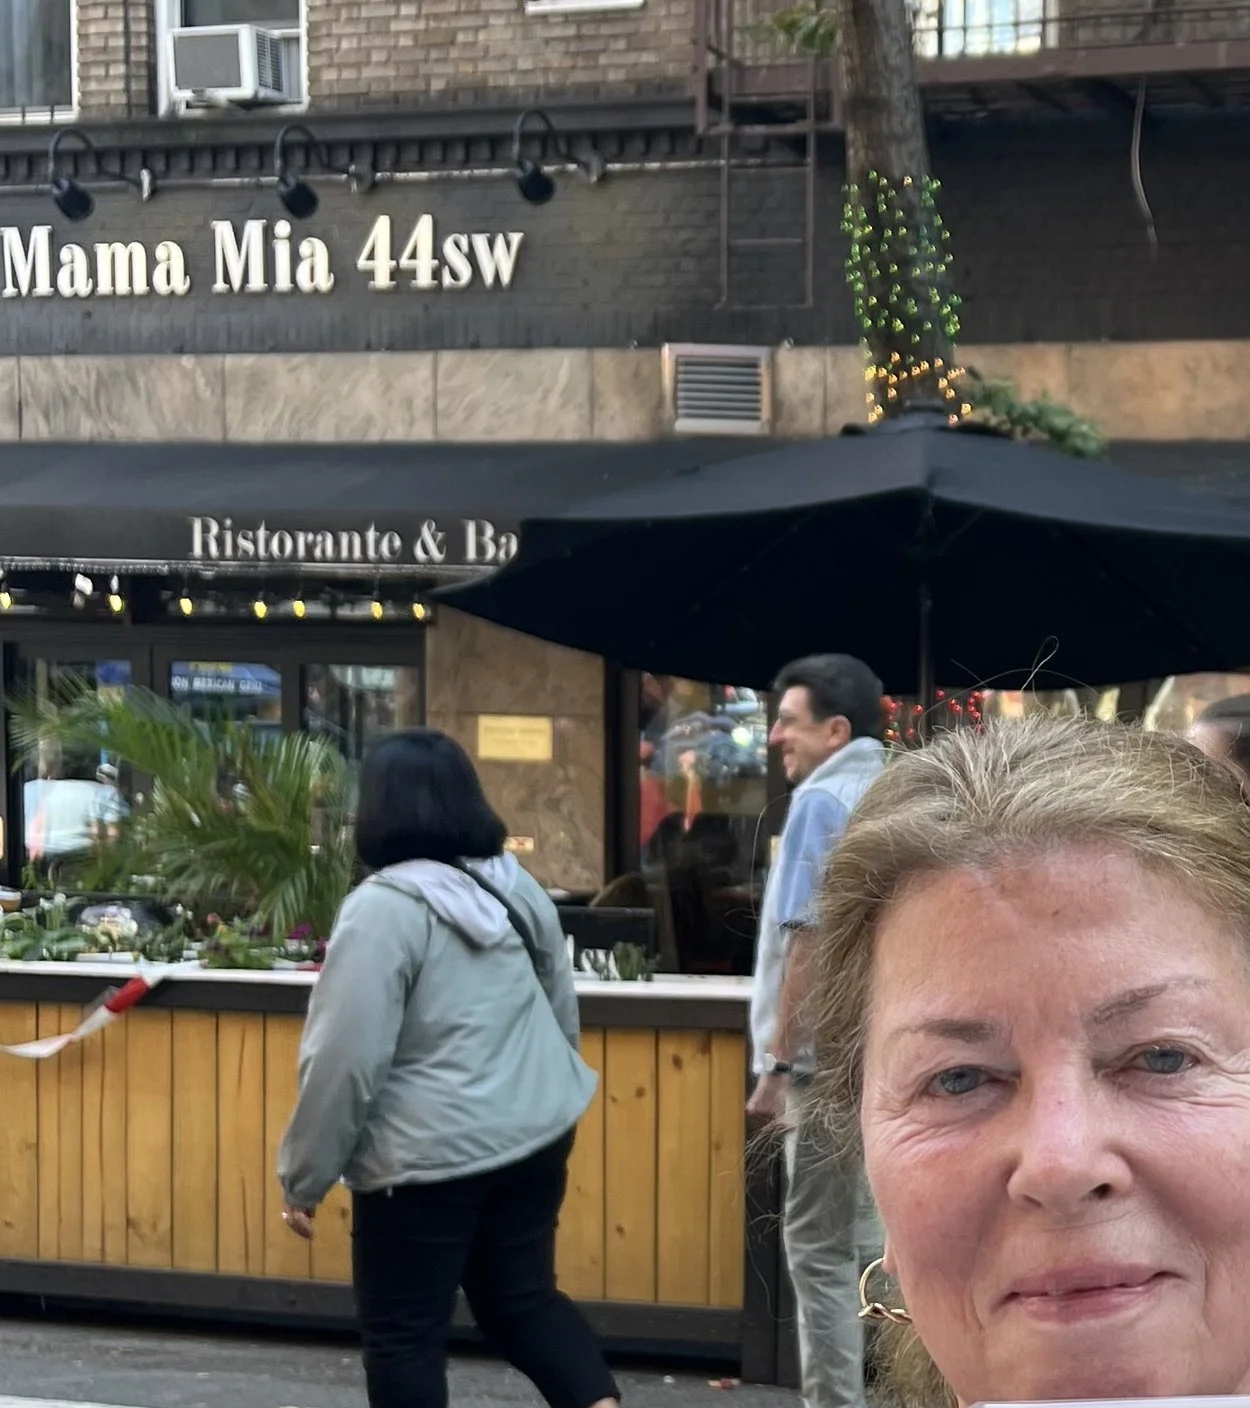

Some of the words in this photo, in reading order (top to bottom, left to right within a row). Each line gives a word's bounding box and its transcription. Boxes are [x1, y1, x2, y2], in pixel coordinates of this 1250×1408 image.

[1, 225, 190, 297] Mama
[211, 219, 335, 294] Mia
[357, 213, 523, 291] 44sw
[188, 516, 402, 561] Ristorante
[413, 519, 447, 563] &
